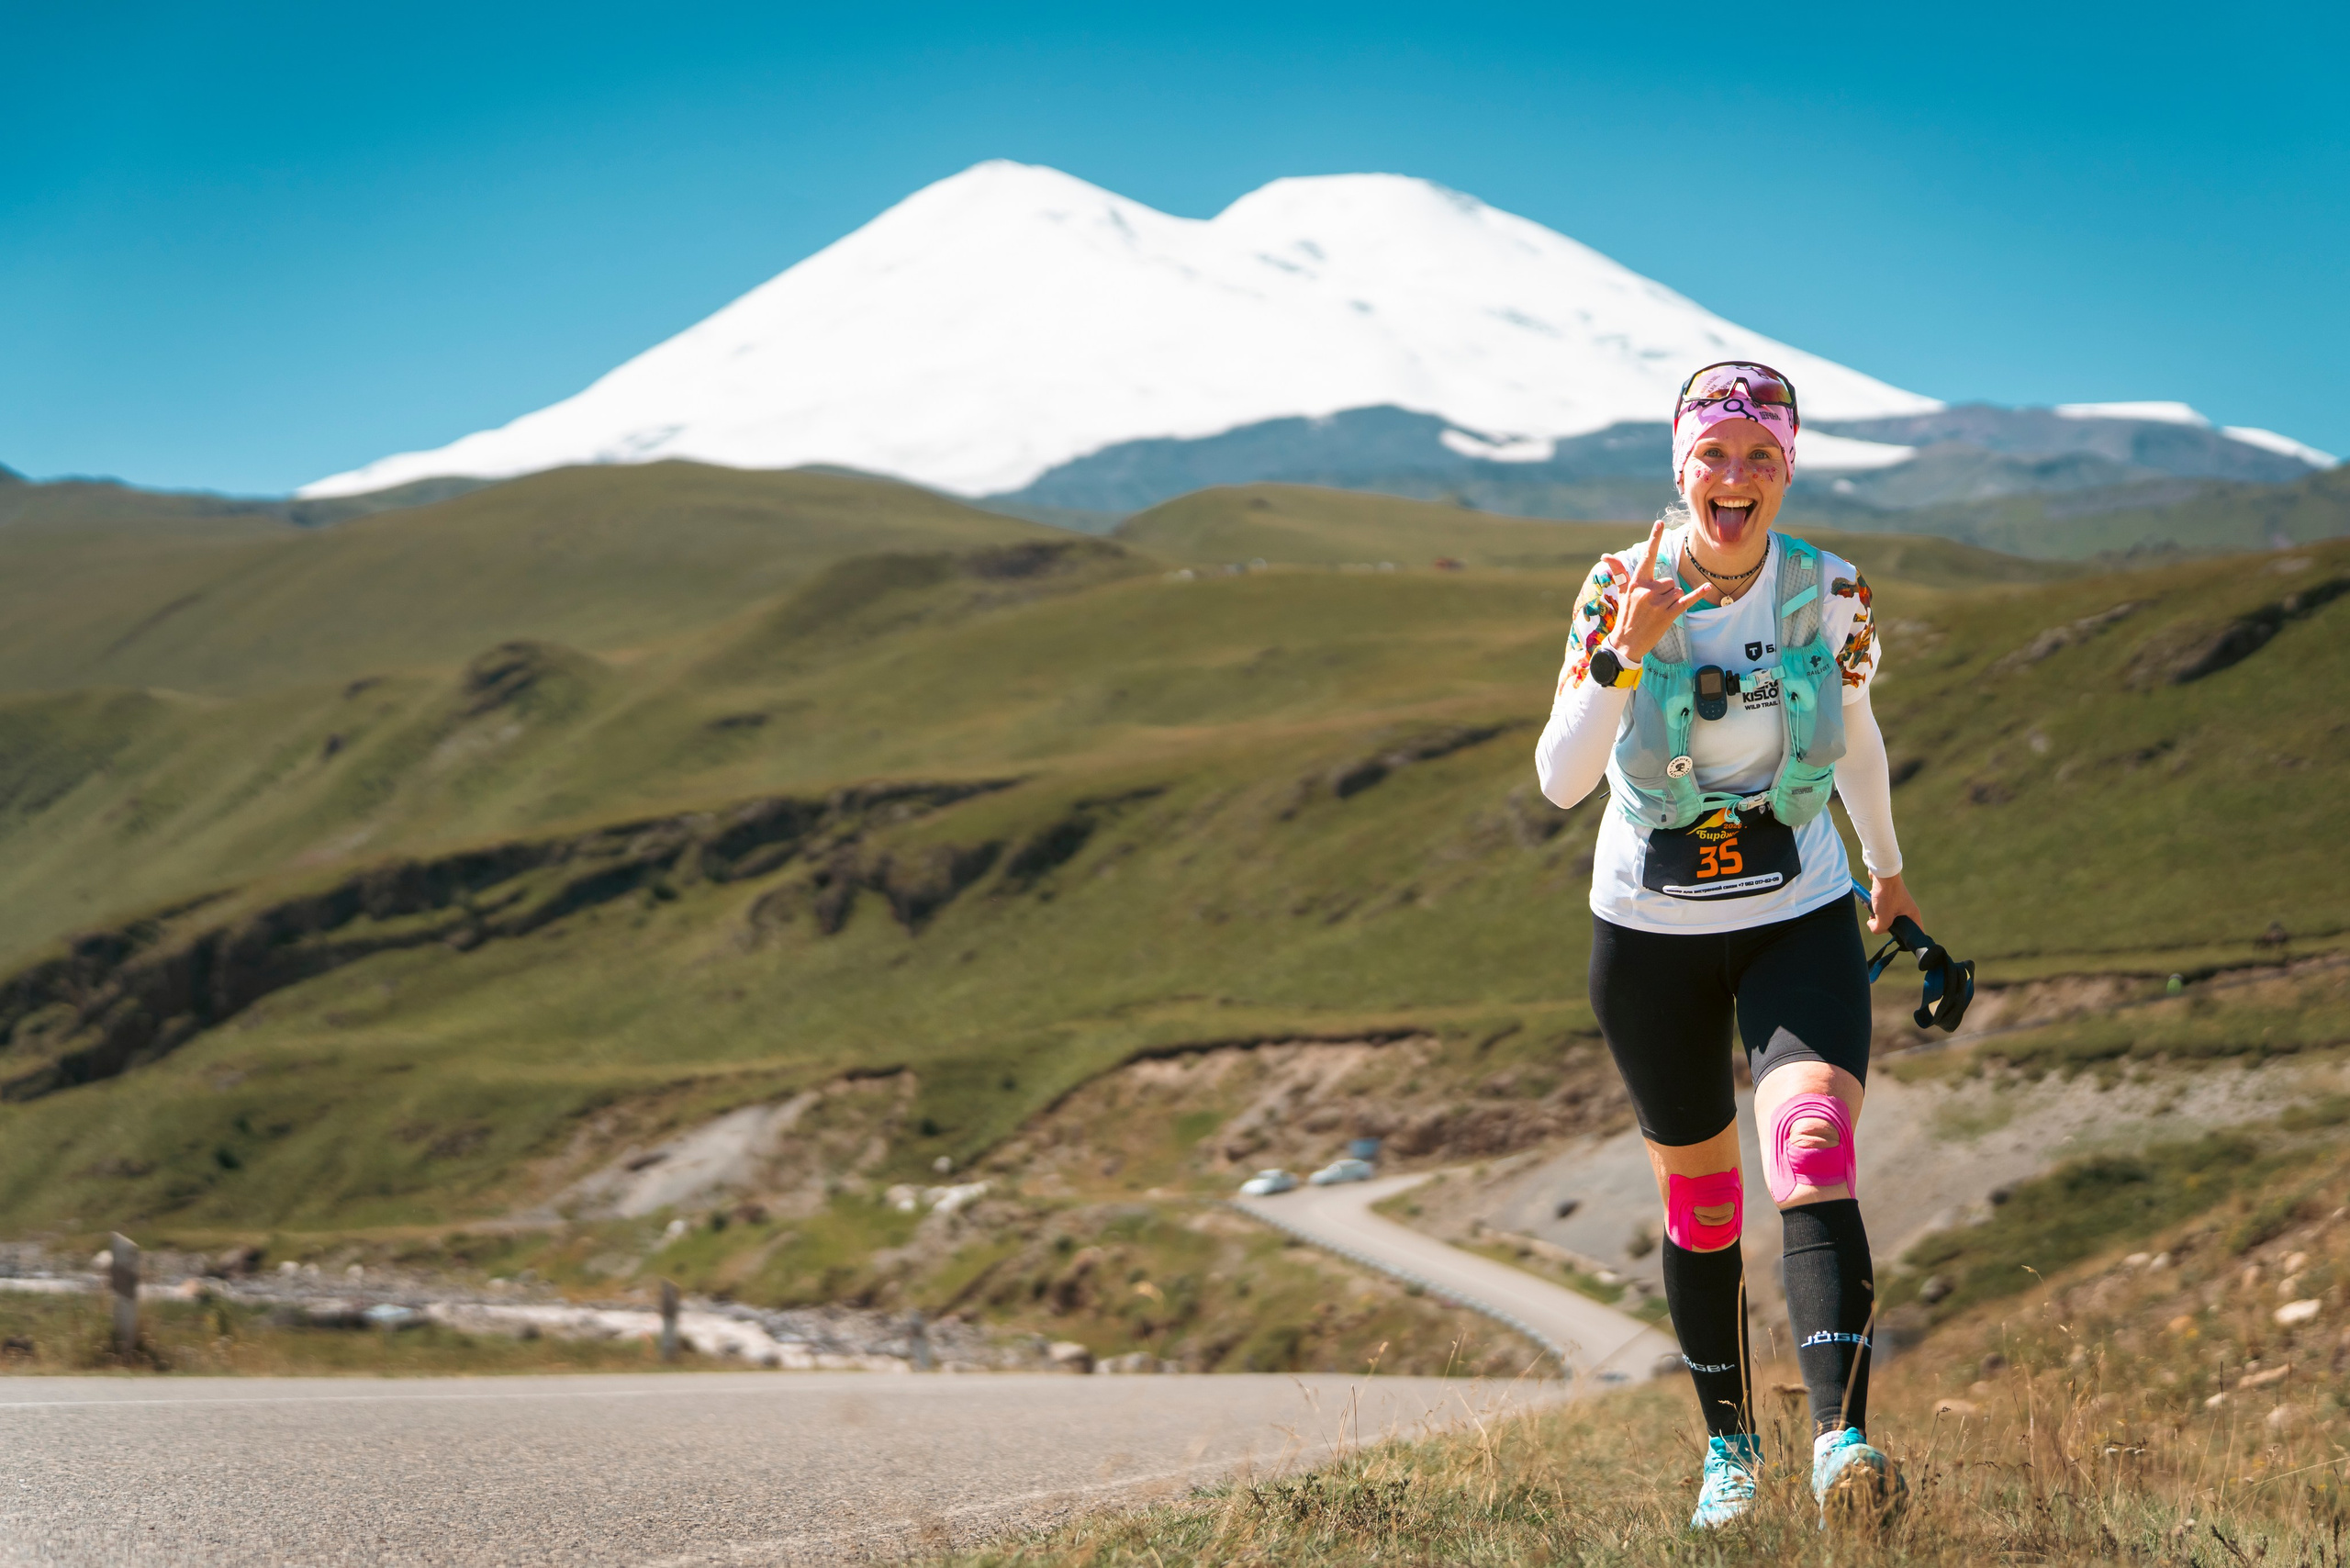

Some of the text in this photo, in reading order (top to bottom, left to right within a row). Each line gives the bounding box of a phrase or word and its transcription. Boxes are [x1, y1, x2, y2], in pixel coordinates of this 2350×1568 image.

[1742, 688, 1779, 703] KISLO
[1696, 837, 1743, 879] 35
[1800, 1330, 1872, 1349] JÖGEL
[1682, 1353, 1736, 1372] ÖGEL
